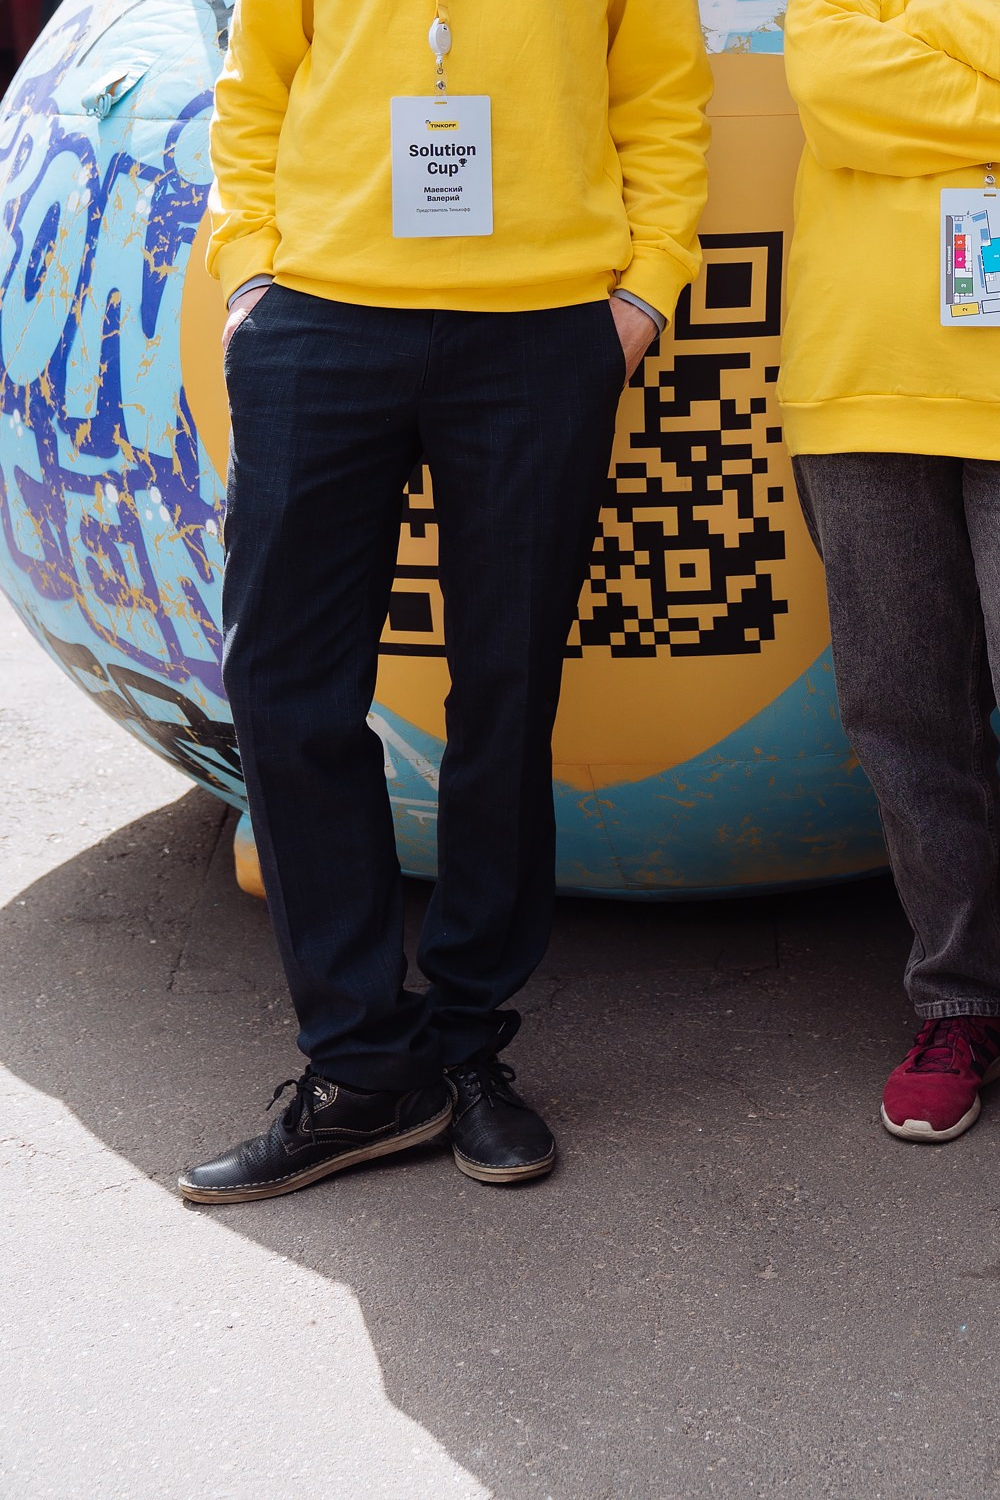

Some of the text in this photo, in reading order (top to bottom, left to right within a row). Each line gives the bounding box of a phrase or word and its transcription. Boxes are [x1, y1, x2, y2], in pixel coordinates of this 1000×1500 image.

[409, 143, 476, 157] Solution
[427, 161, 459, 177] Cup
[423, 185, 463, 194] Маевский
[427, 194, 460, 203] Валерий
